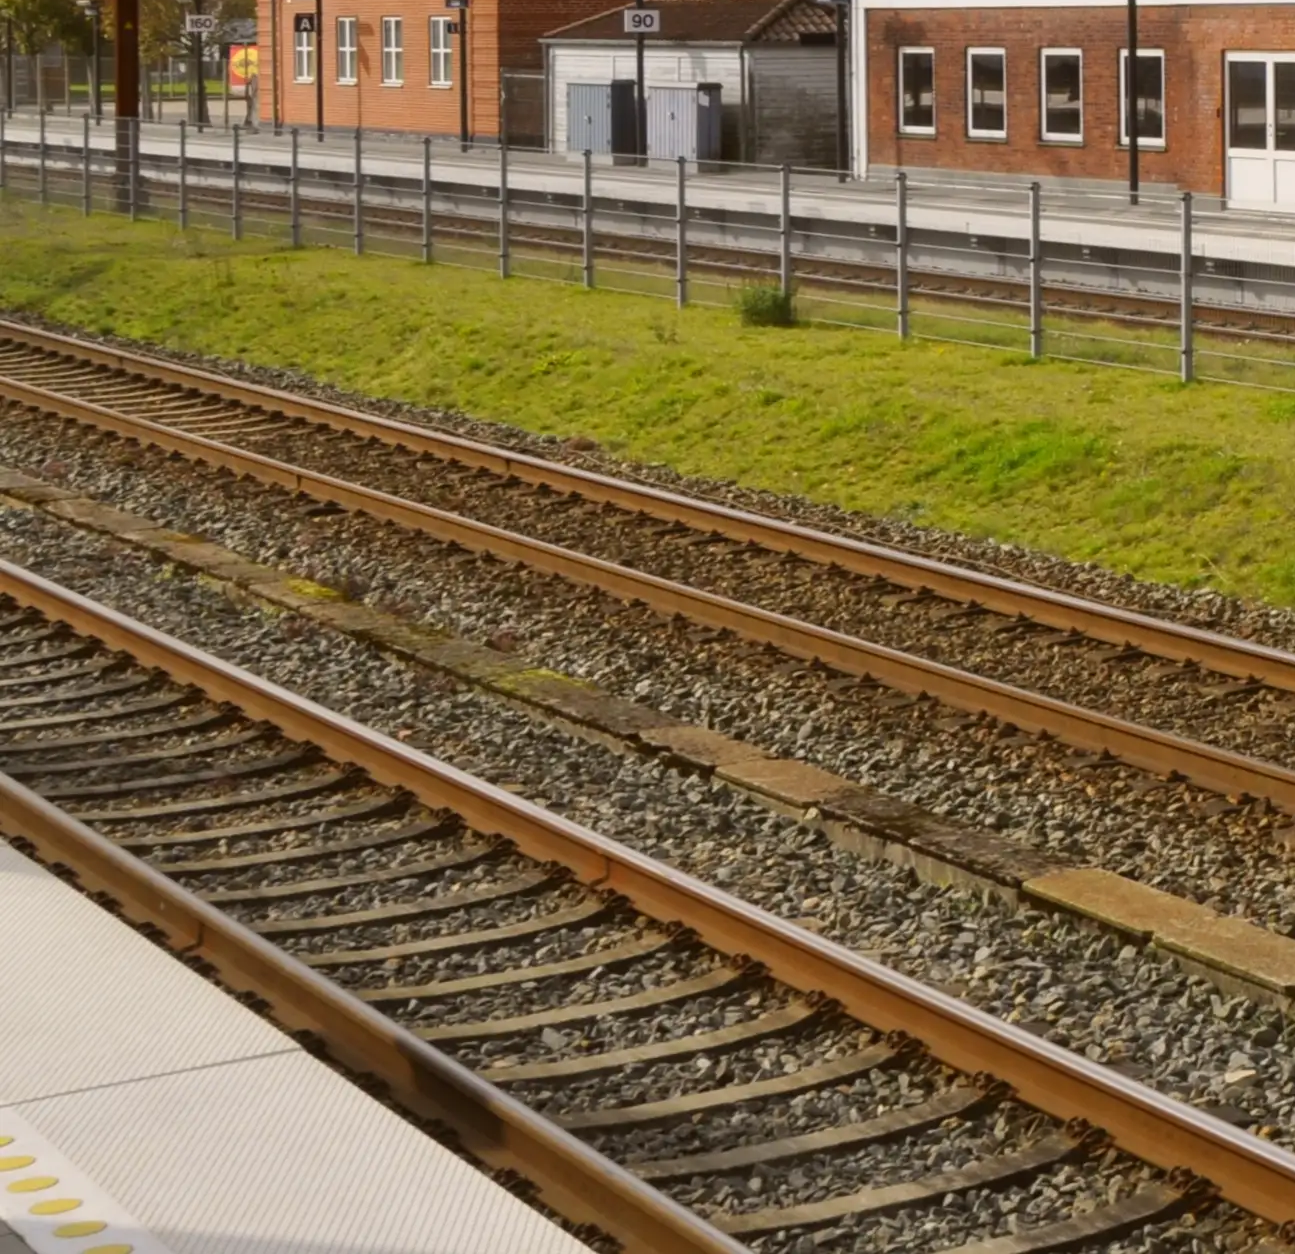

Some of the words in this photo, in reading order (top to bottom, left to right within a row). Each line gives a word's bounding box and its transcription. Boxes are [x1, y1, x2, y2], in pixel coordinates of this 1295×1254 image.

[190, 18, 213, 28] 160
[300, 18, 312, 30] A
[632, 14, 654, 28] 90
